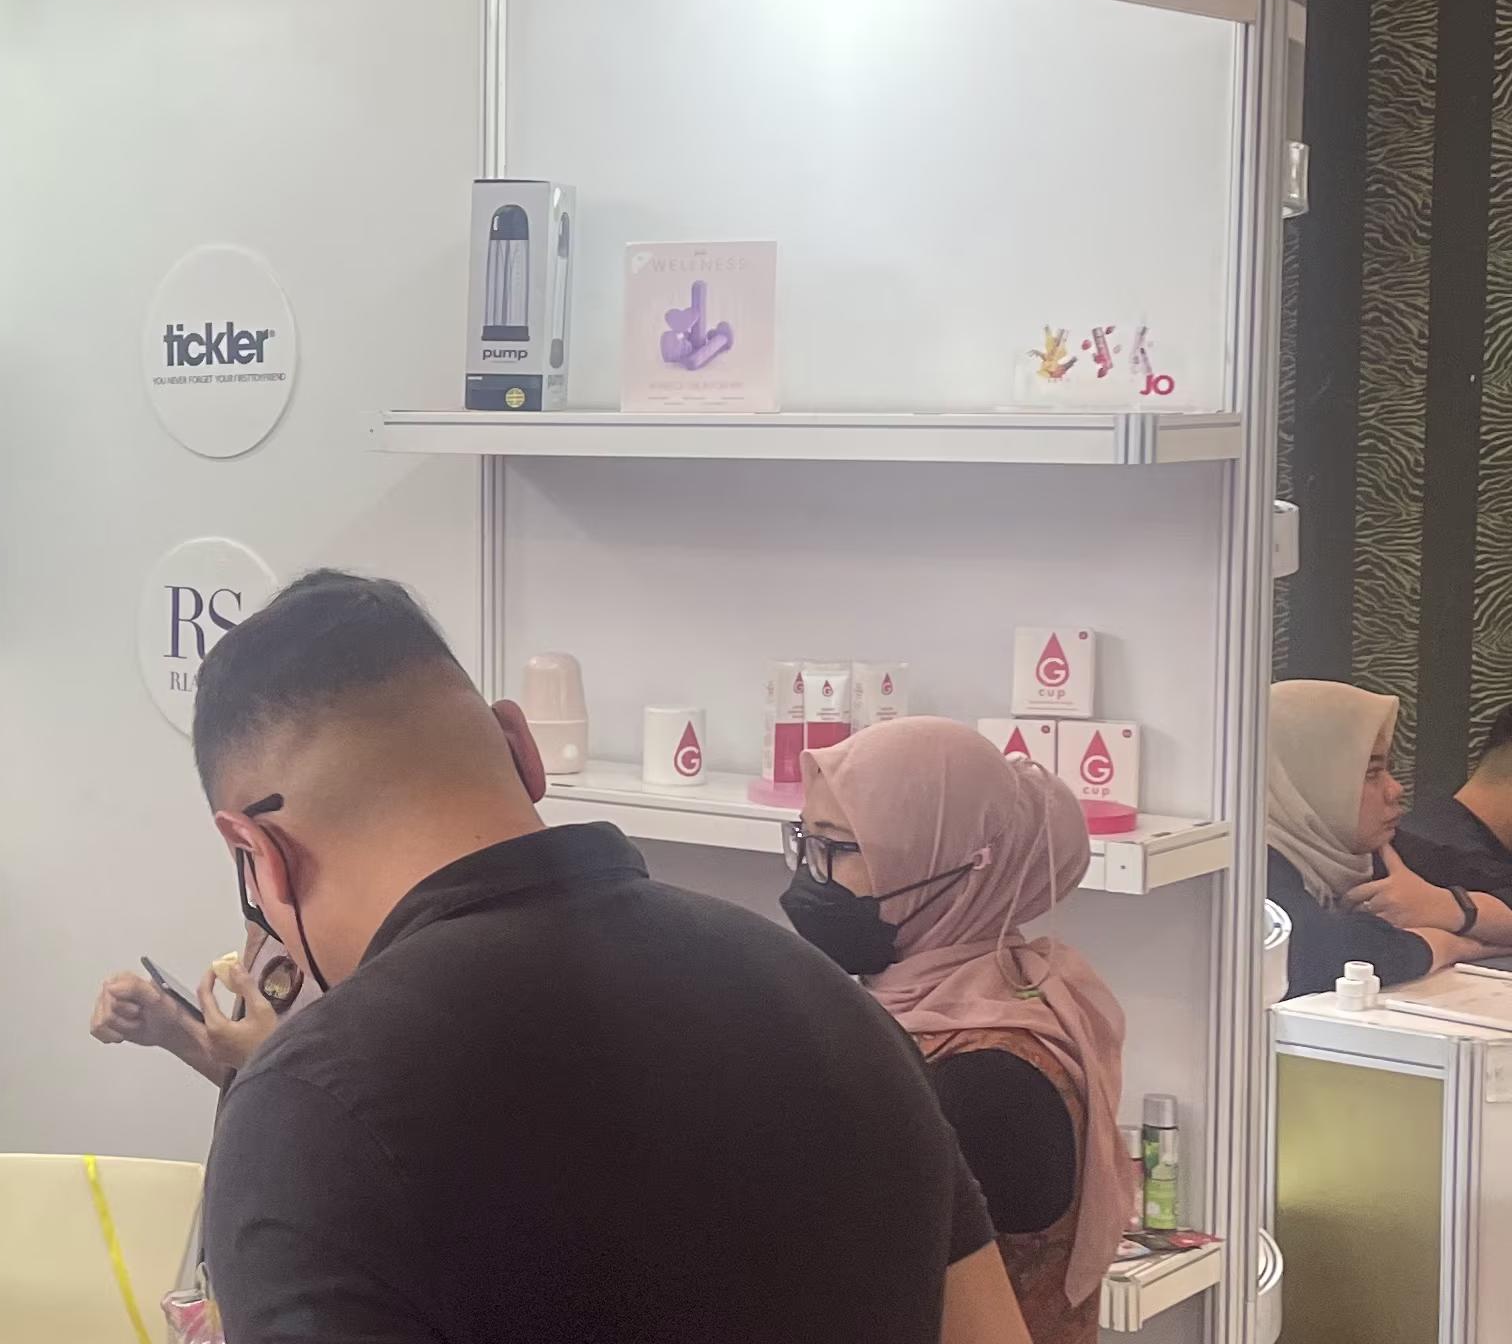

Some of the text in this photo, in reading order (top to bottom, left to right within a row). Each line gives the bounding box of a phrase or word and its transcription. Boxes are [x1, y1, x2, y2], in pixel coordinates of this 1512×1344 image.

[482, 349, 528, 361] pump
[1140, 374, 1175, 396] JO
[1038, 687, 1066, 699] cup
[1082, 786, 1111, 798] cup
